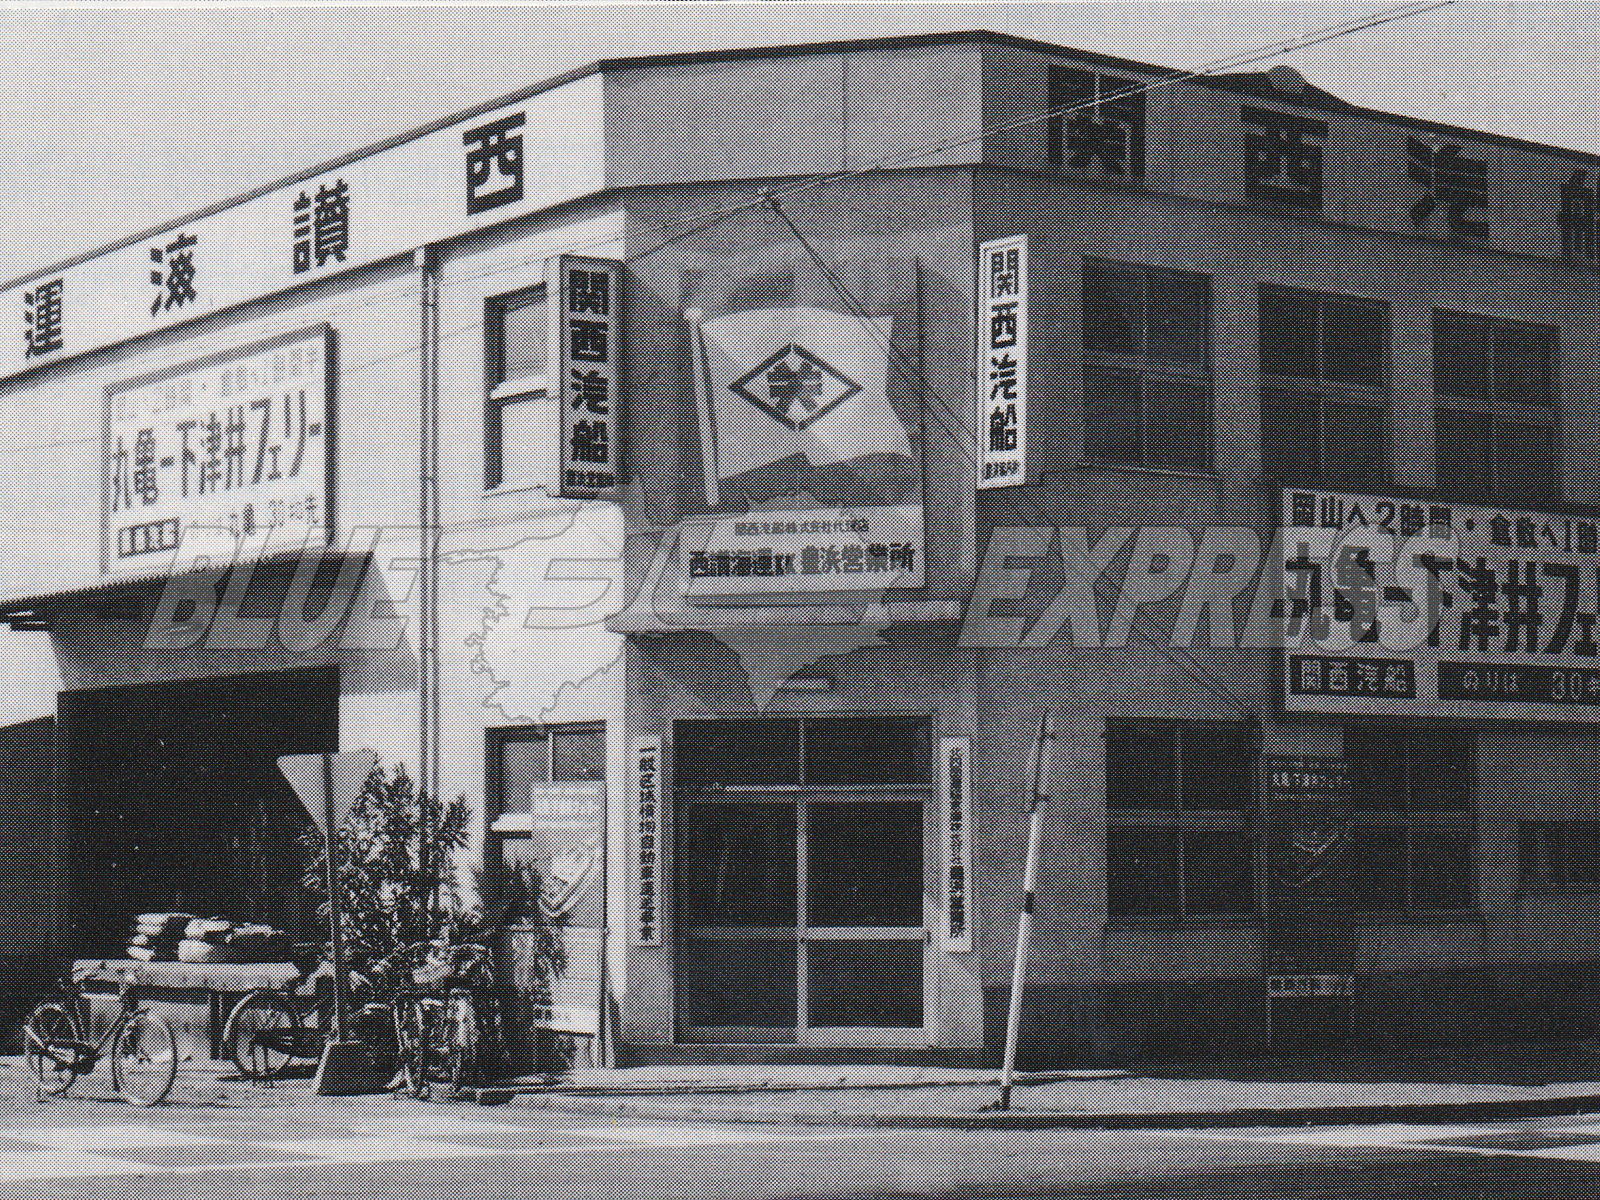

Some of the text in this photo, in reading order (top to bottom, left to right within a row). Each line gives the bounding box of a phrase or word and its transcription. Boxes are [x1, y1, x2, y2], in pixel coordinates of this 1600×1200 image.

[569, 268, 609, 464] 関西汽船
[989, 248, 1019, 452] 関西汽船
[801, 542, 916, 576] 豊浜営業所
[1300, 660, 1408, 693] 関西汽船
